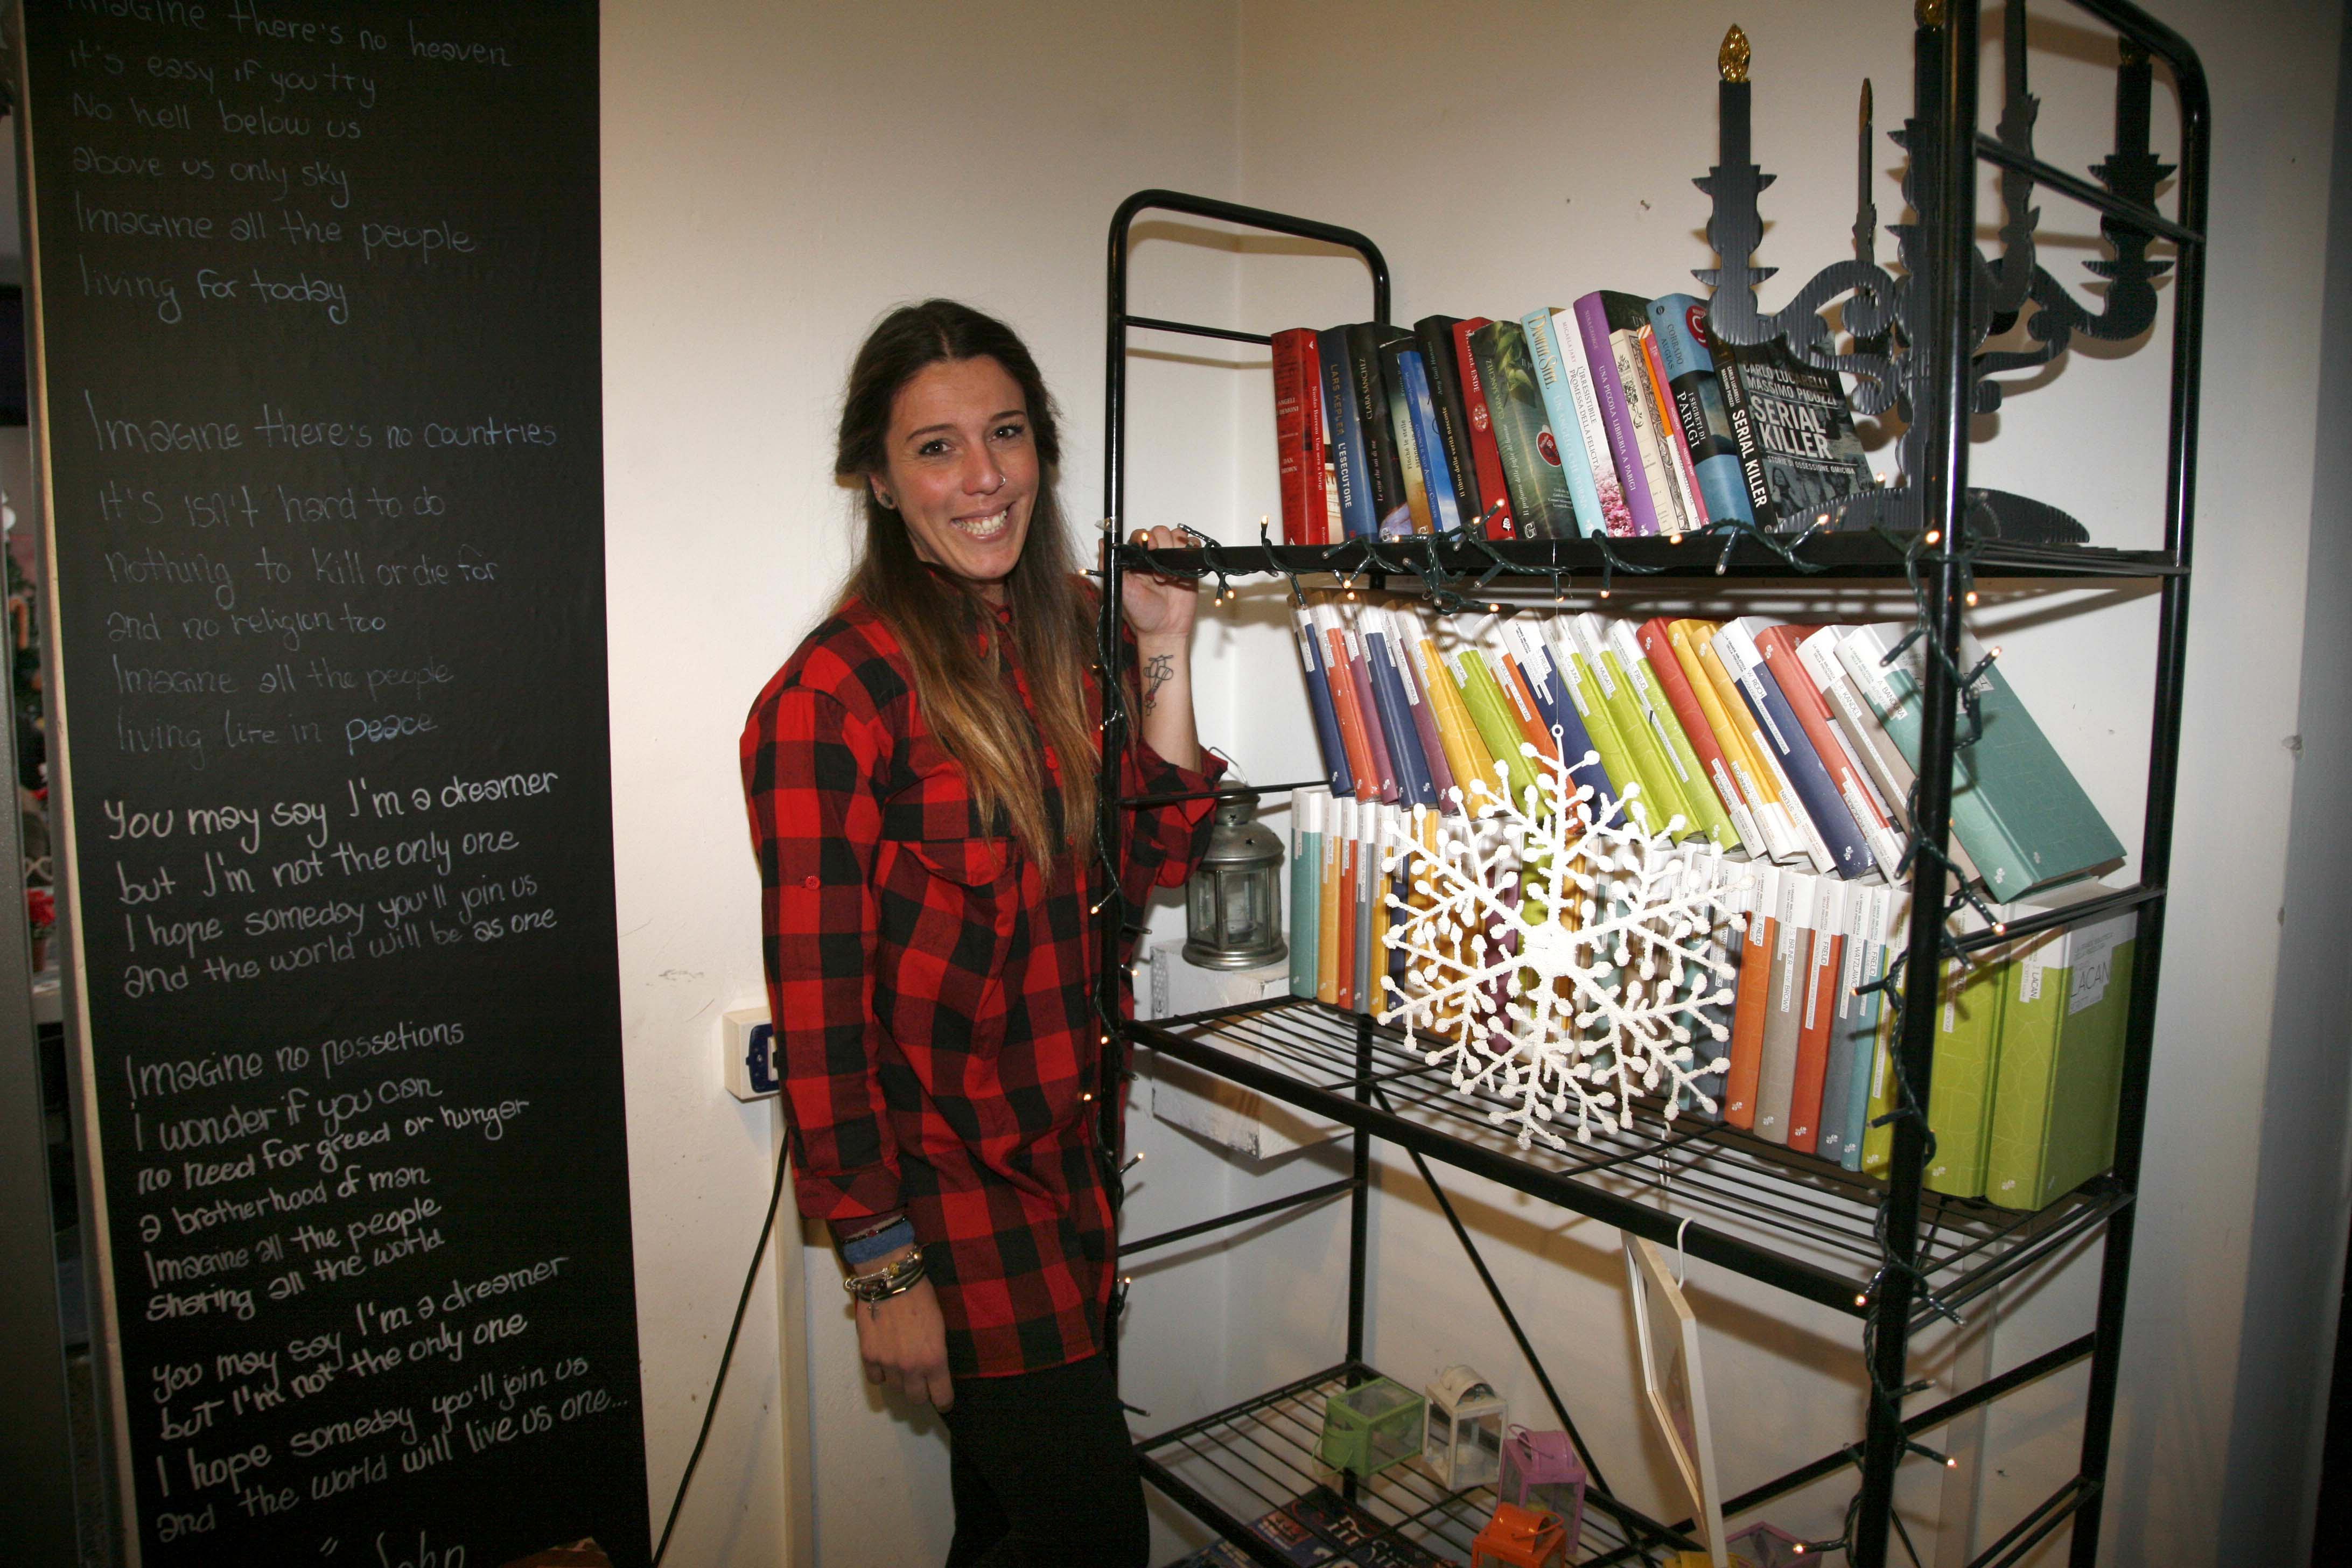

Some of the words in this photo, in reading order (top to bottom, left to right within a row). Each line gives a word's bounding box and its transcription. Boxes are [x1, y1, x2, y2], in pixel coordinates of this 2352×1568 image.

[130, 97, 191, 130] hell
[219, 100, 310, 136] below
[327, 120, 361, 139] us
[79, 254, 182, 324] living
[251, 270, 348, 325] today
[1662, 338, 1675, 370] AUGIAS
[1668, 324, 1684, 365] CORRADO
[1331, 364, 1340, 391] LARS
[1471, 370, 1480, 393] ENDE
[1742, 363, 1774, 377] CARLO
[1776, 369, 1829, 389] LUCARELLI
[1746, 376, 1794, 398] MASSIMO
[1796, 388, 1838, 405] PICOZZI
[1364, 395, 1372, 419] CLARA
[1495, 396, 1504, 419] CLARA
[1570, 369, 1582, 409] PROMESSA
[1579, 410, 1588, 435] DELLA
[1575, 366, 1597, 424] L'IRRESISTIBILE
[255, 404, 373, 449] there's
[387, 426, 412, 450] no
[425, 415, 557, 448] countries
[1334, 395, 1344, 436] KEPLER
[1442, 407, 1453, 436] nascoste
[1677, 391, 1700, 448] PARIGI
[1689, 397, 1703, 433] SEGRETI
[1699, 431, 1706, 440] DI
[1751, 396, 1826, 434] SERIAL
[1604, 384, 1618, 418] PICCOLA
[1612, 418, 1625, 455] LIBRERIA
[1625, 465, 1636, 491] PARIGI
[1759, 422, 1833, 459] KILLER
[1338, 443, 1352, 508] L'ESECUTORE
[1732, 409, 1754, 458] SERIAL
[1744, 458, 1769, 510] KILLER
[1767, 456, 1788, 466] STORIE
[1795, 461, 1830, 472] OSSESSIONE
[107, 611, 160, 641] and
[183, 611, 219, 640] no
[232, 607, 331, 651] religion
[340, 603, 386, 634] too
[1570, 667, 1581, 683] JUNG
[1599, 667, 1614, 691] MUSATTI
[1634, 670, 1647, 689] FREUD
[1752, 679, 1765, 697] REICH
[1843, 692, 1859, 717] KANDEL
[1713, 775, 1732, 806] BASAGLIA
[1780, 790, 1795, 812] STERN
[187, 805, 261, 855] may
[270, 801, 328, 849] say
[347, 777, 405, 819] I'm
[411, 787, 431, 811] a
[439, 771, 559, 809] dreamer
[116, 861, 177, 904] but
[272, 851, 325, 887] not
[330, 843, 391, 876] the
[395, 831, 451, 876] only
[461, 830, 520, 855] one
[124, 914, 136, 951] I
[146, 914, 223, 959] hope
[244, 900, 365, 938] someday
[377, 884, 447, 928] you'll
[459, 874, 506, 925] join
[510, 873, 538, 898] us
[203, 957, 261, 983] the
[270, 934, 356, 972] world
[369, 923, 421, 959] will
[431, 919, 463, 946] be
[472, 919, 505, 943] as
[510, 905, 558, 934] one
[1755, 923, 1763, 945] FREUD
[1787, 939, 1795, 965] BRUNER
[1821, 942, 1829, 965] FREUD
[1869, 951, 1878, 976] FREUD
[1782, 985, 1790, 1012] BROWN
[2029, 971, 2041, 998] LACAN
[276, 1044, 309, 1072] no
[159, 1104, 277, 1151] wonder
[279, 1086, 310, 1126] if
[317, 1089, 372, 1138] you
[377, 1076, 443, 1104] can
[138, 1167, 171, 1195] no
[183, 1153, 256, 1191] need
[262, 1138, 311, 1171] for
[316, 1123, 391, 1173] greed
[404, 1116, 433, 1138] or
[439, 1100, 530, 1142] hunger
[216, 1348, 277, 1384] may
[288, 1331, 342, 1369] say
[356, 1301, 412, 1336] I'm
[417, 1294, 435, 1320] a
[442, 1255, 570, 1313] dreamer
[156, 1454, 170, 1496] I
[187, 1443, 271, 1494] hope
[290, 1406, 417, 1457] someday
[432, 1378, 494, 1433] you'll
[498, 1364, 547, 1410] join
[555, 1356, 588, 1380] us
